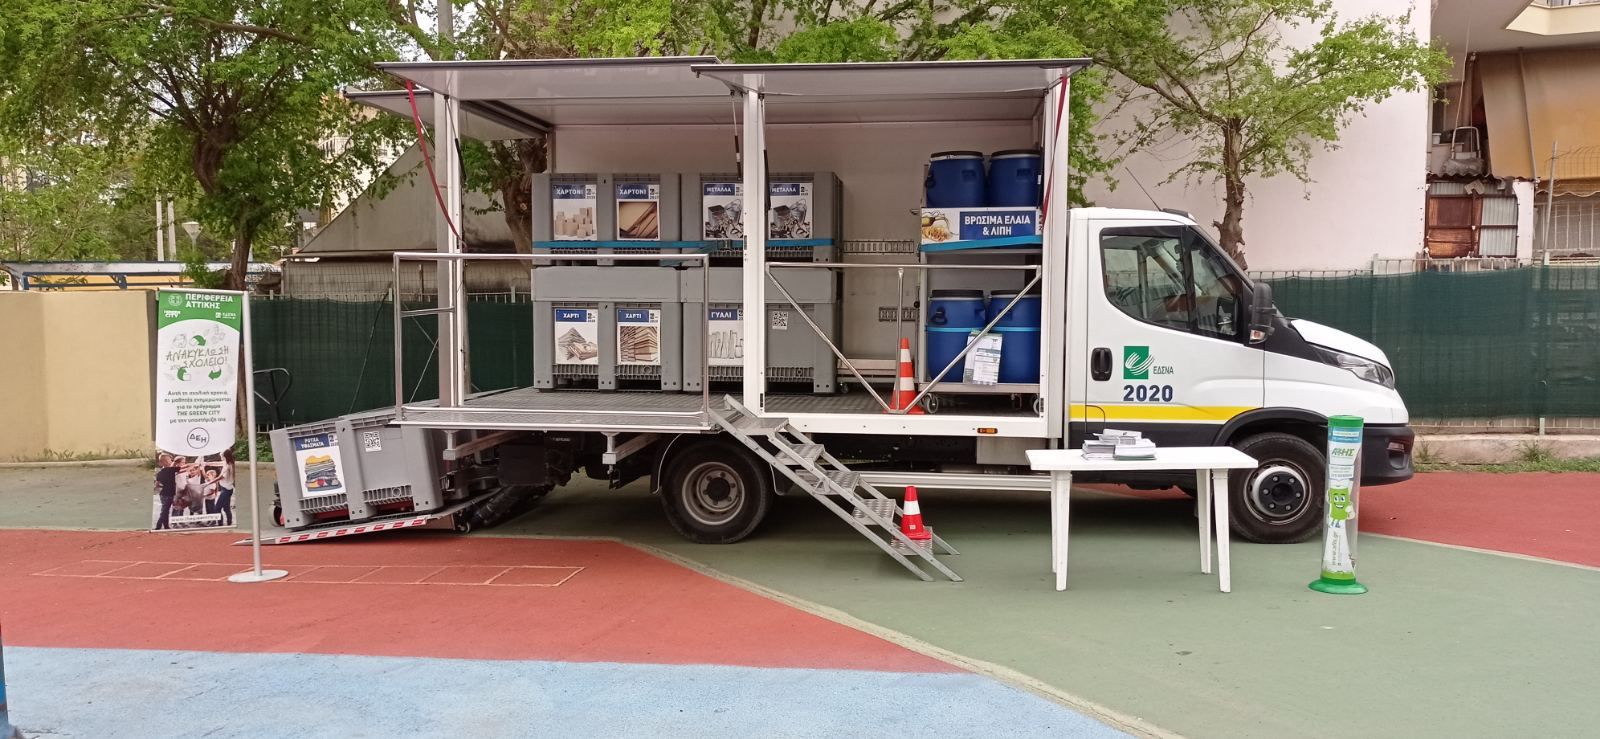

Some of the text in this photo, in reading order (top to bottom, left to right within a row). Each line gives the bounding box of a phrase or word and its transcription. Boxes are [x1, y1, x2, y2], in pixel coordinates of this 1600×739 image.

[964, 214, 1031, 225] ΒΡΩΣΙΜΑ ΕΛΑΙΑ
[982, 226, 1012, 236] & ΛΙΠΗ
[185, 293, 233, 302] ΠΕΡΙΦΕΡΕΙΑ
[185, 301, 221, 309] ΑΤΤΙΚΗΣ
[1153, 366, 1174, 375] ΕΔΣΝΑ
[1123, 384, 1173, 402] 2020
[190, 433, 207, 442] ΔΕΗ
